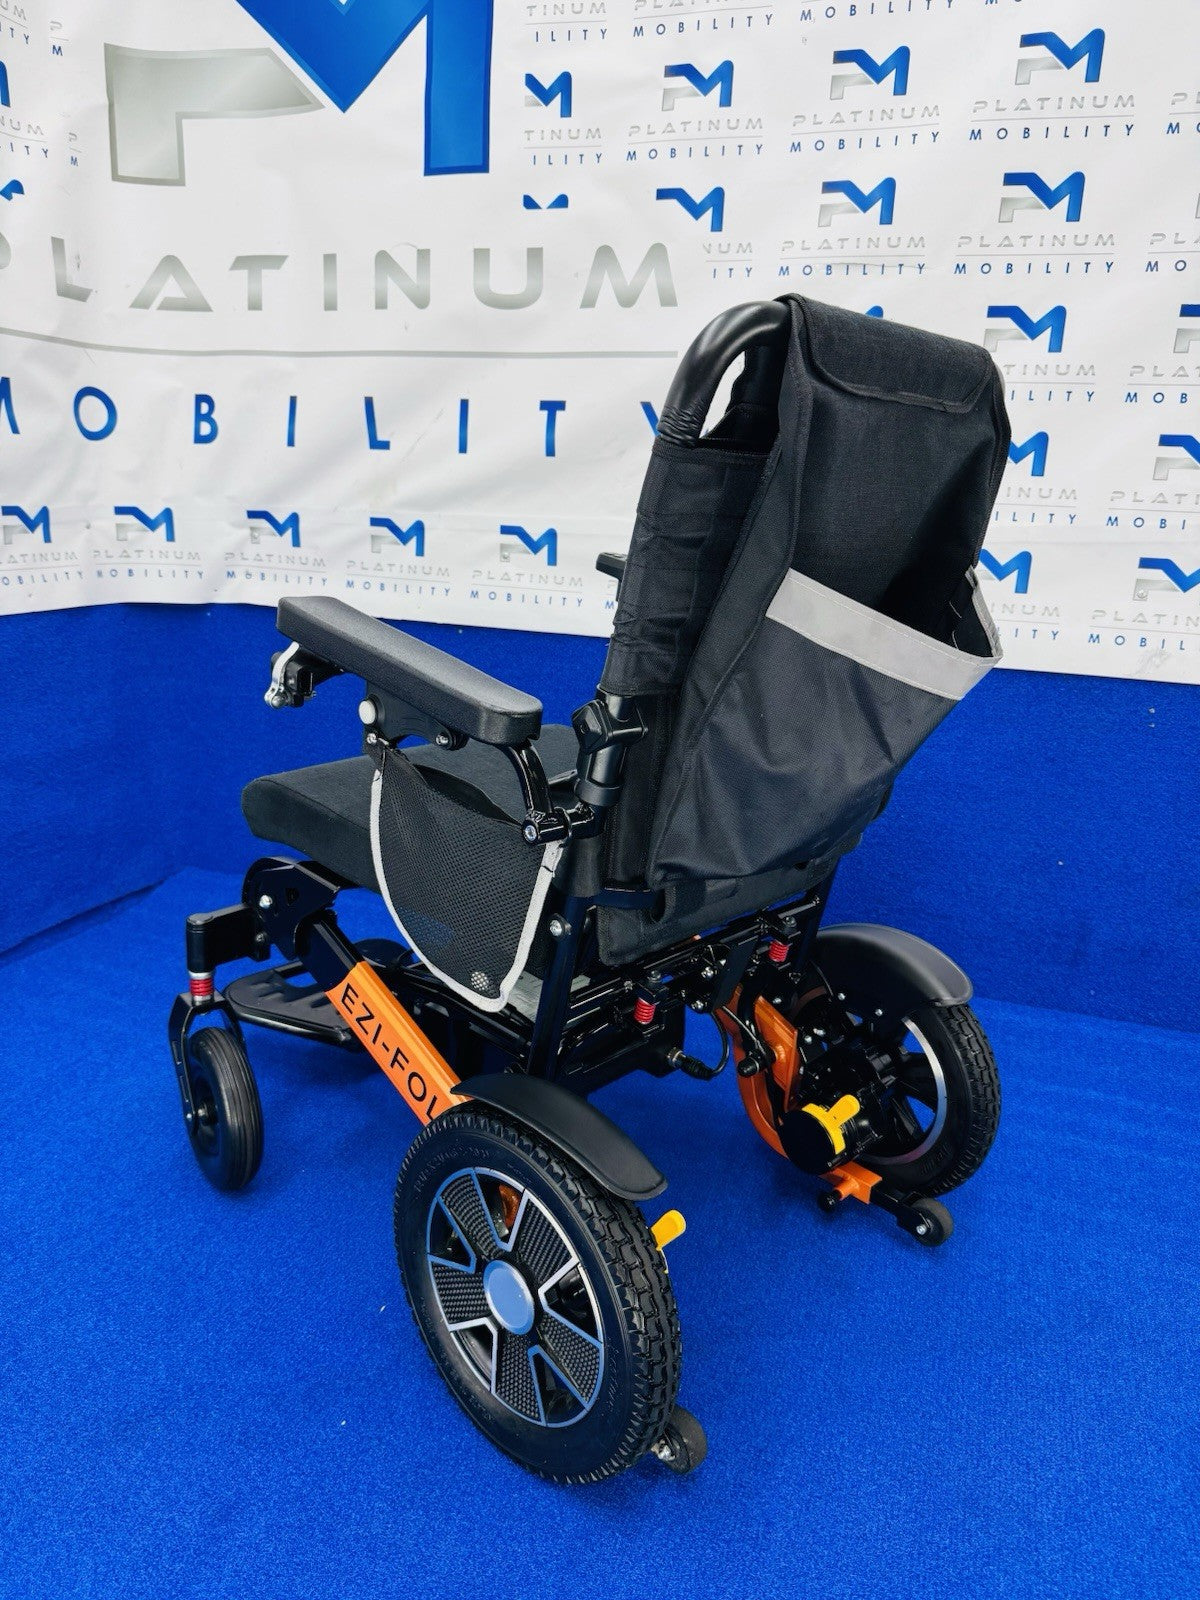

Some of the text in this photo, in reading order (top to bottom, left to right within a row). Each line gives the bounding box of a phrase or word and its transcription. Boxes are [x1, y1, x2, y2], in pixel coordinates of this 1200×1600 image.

[633, 14, 773, 37] MOBILITY
[972, 94, 1136, 114] PLATINUM
[792, 105, 940, 128] PLATINUM
[628, 117, 764, 138] PLATINUM
[969, 124, 1135, 141] MOBILITY
[790, 131, 940, 153] MOBILITY
[626, 144, 764, 161] MOBILITY
[782, 236, 926, 252] PLATINUM
[957, 234, 1115, 249] PLATINUM
[0, 232, 677, 312] LATINUM
[779, 263, 926, 277] MOBILITY
[954, 261, 1114, 276] MOBILITY
[0, 552, 78, 565] ATINUM
[93, 550, 202, 560] PLATINUM
[224, 552, 326, 567] PLATINUM
[346, 560, 450, 577] PLATINUM
[226, 570, 328, 586] MOBILITY
[472, 570, 583, 587] PLATINUM
[345, 580, 450, 596] MOBILITY
[470, 590, 583, 607] MOBILITY
